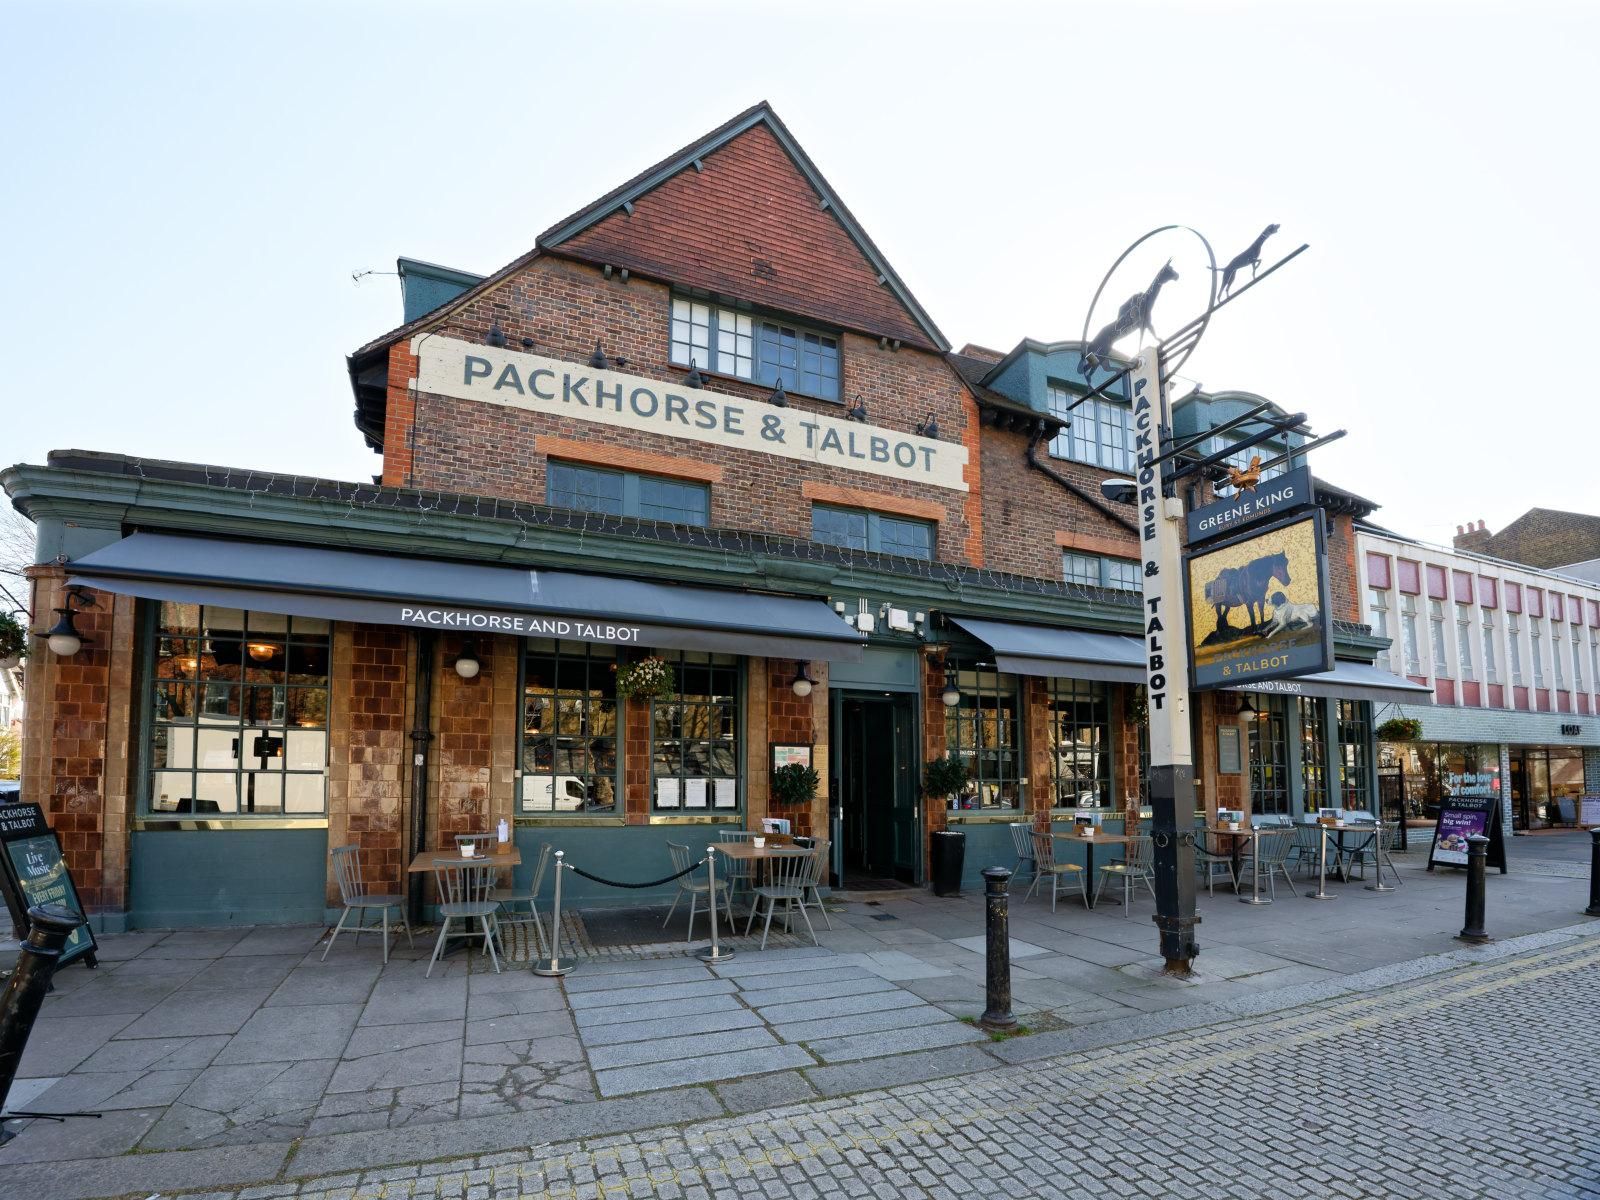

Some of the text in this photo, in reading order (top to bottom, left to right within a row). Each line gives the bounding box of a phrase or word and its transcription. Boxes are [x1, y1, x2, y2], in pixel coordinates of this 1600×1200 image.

[464, 355, 937, 472] PACKHORSE & TALBOT
[1199, 486, 1294, 531] GREENE KING
[1134, 377, 1166, 710] PACKHORSE & TALBOT
[401, 608, 640, 641] PACKHORSE AND TALBOT
[1222, 665, 1232, 676] &
[1235, 655, 1289, 673] TALBOT
[1257, 681, 1274, 691] AND
[1275, 682, 1302, 693] TALBOT
[1448, 771, 1492, 783] For the love
[8, 818, 36, 831] TALBOT
[1443, 817, 1454, 826] big
[25, 852, 43, 866] Live
[26, 862, 51, 877] Music
